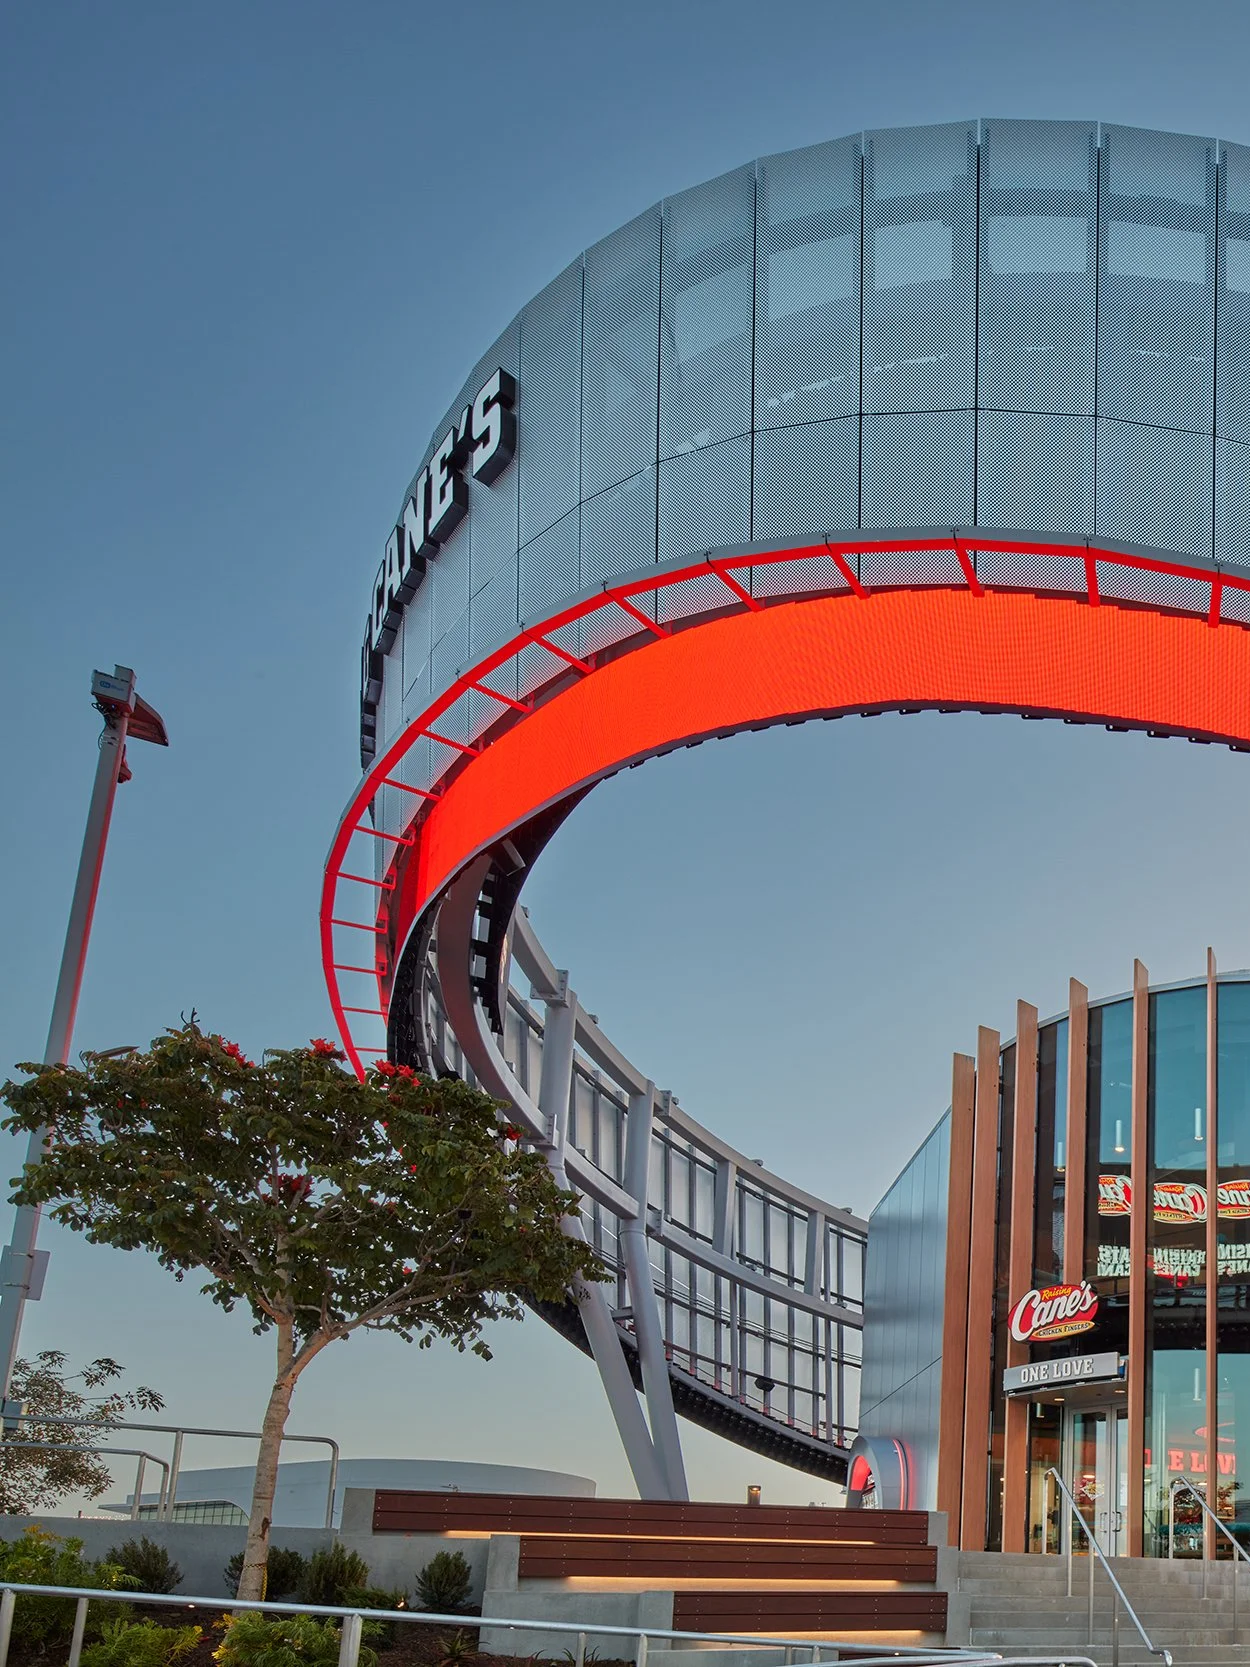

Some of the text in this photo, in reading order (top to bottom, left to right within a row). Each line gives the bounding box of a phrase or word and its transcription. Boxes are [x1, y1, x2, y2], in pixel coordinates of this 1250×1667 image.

[1042, 1286, 1071, 1300] Raising
[1011, 1280, 1097, 1341] Cane's
[1021, 1358, 1094, 1384] ONE LOVE
